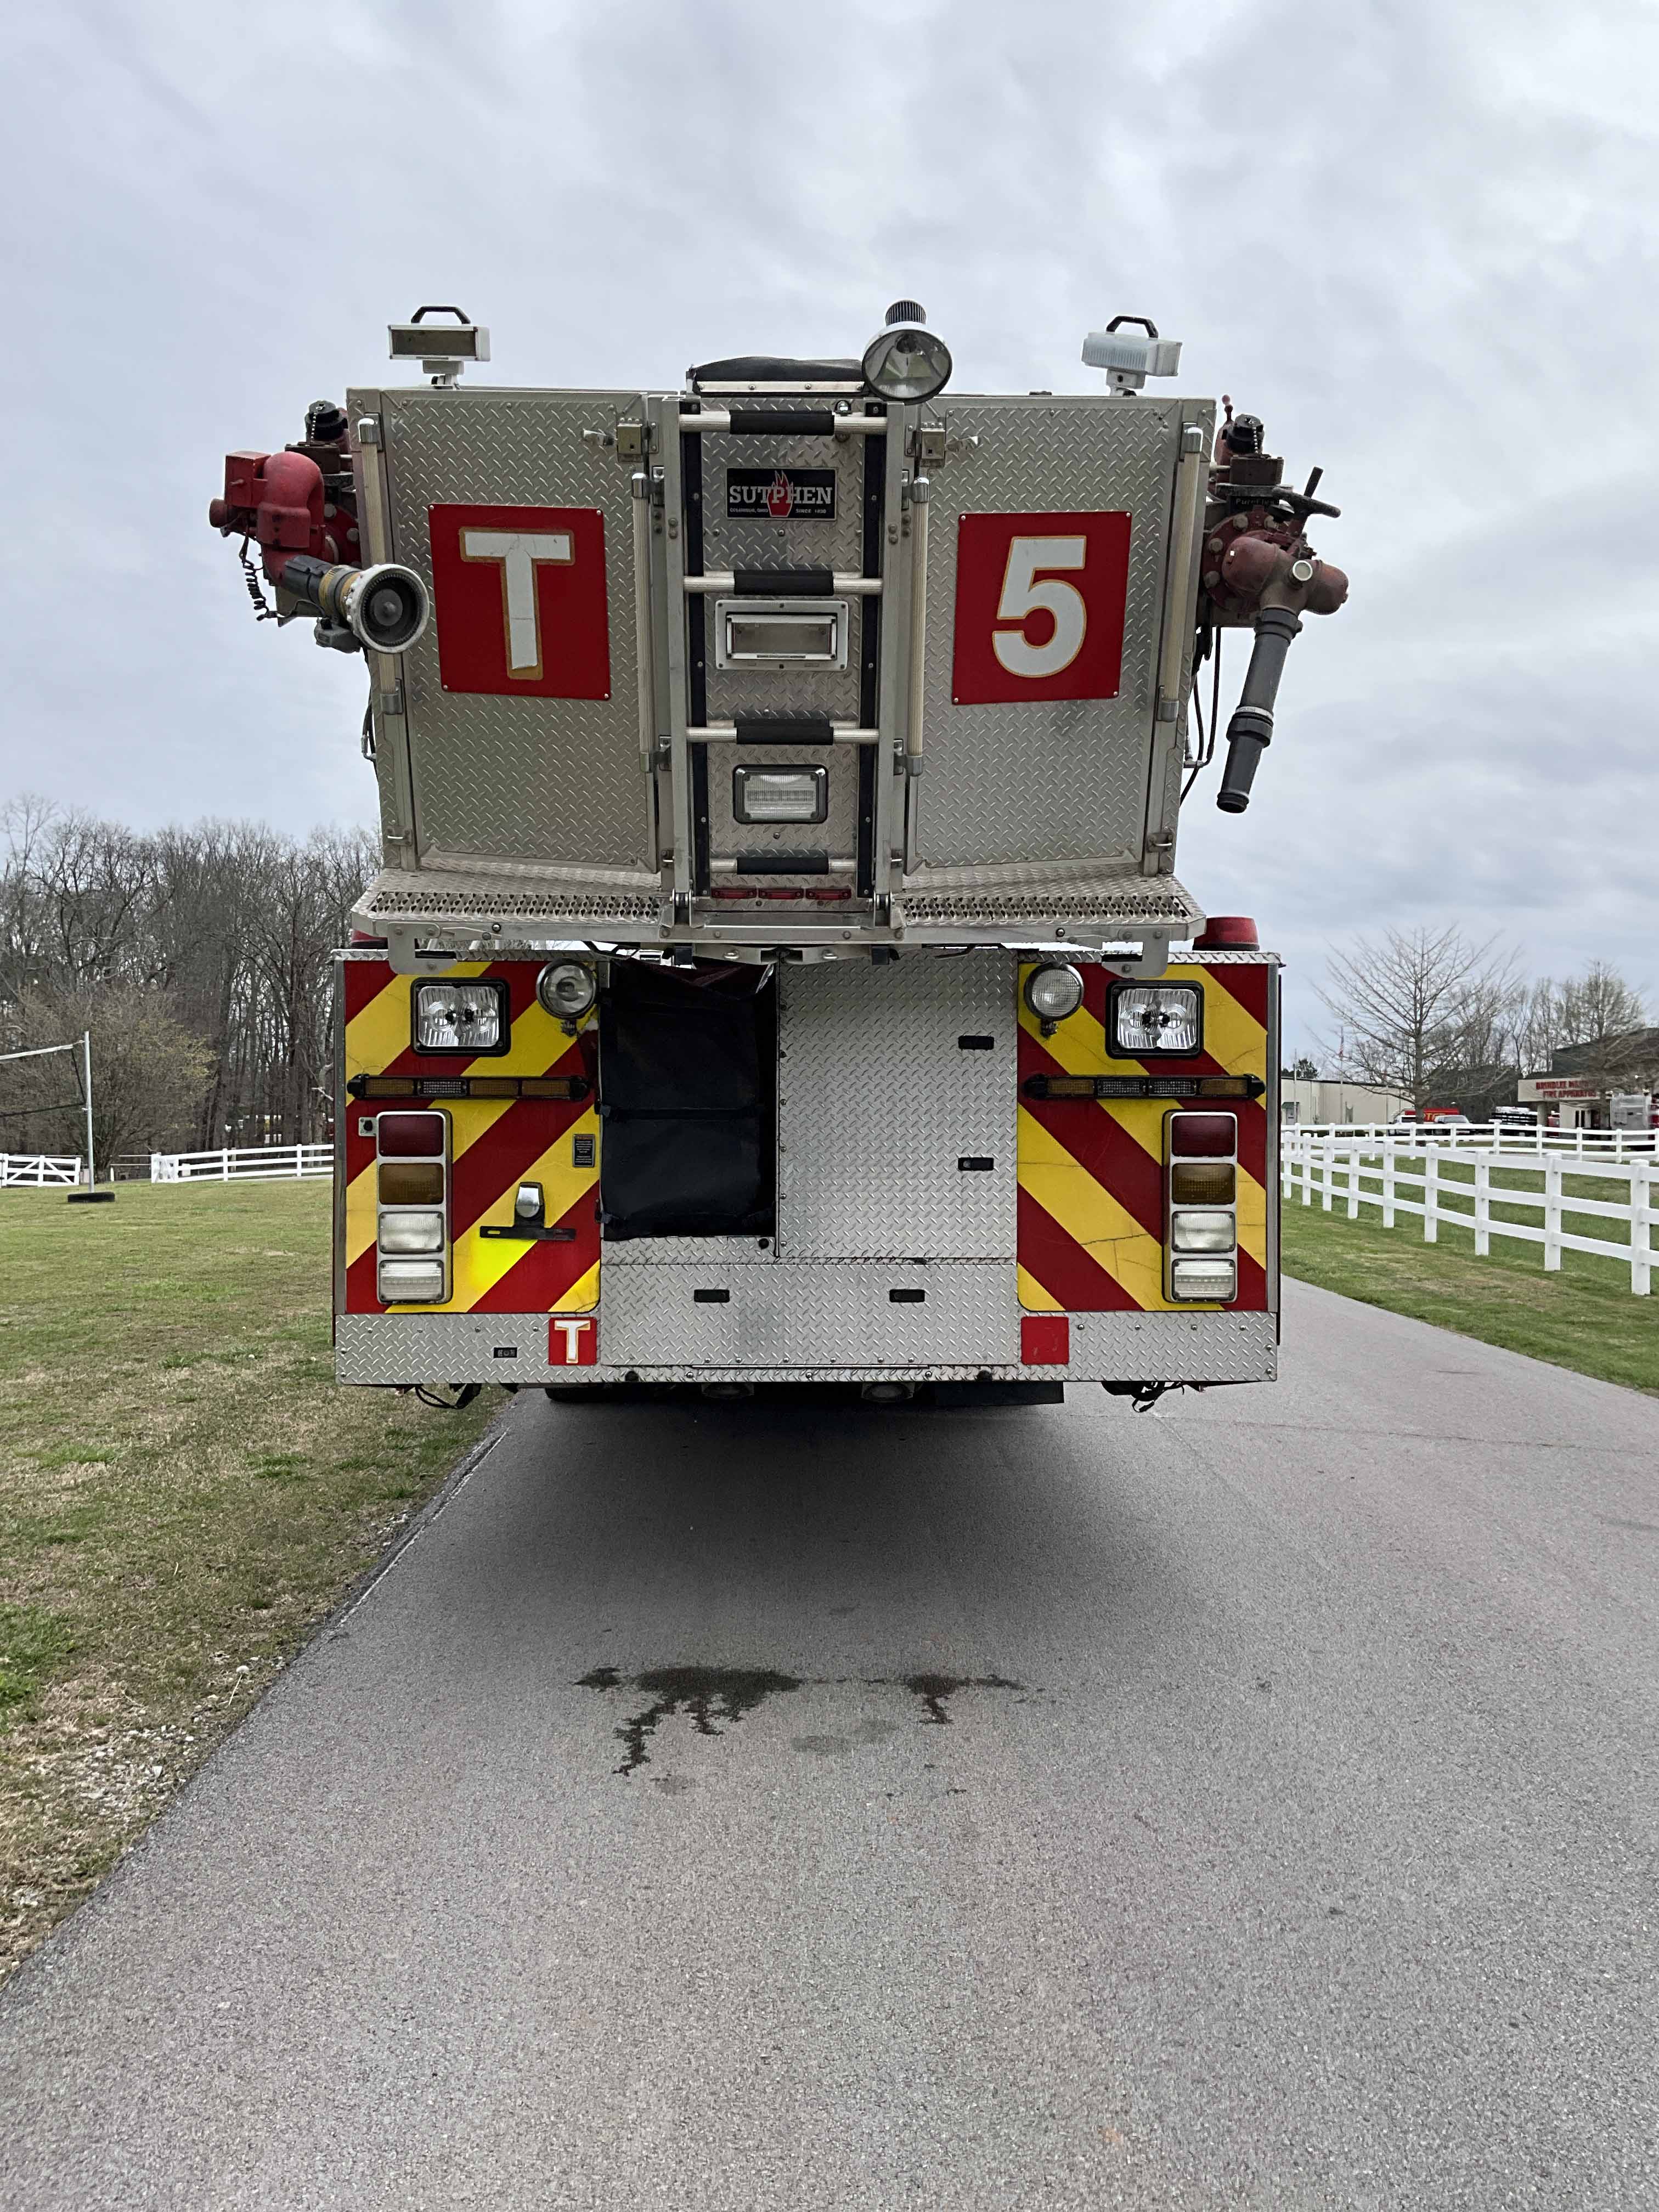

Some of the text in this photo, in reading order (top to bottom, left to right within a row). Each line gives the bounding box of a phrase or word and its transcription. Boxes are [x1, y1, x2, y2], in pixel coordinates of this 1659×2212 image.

[729, 485, 832, 505] SUTPHEN
[460, 527, 574, 680] T
[992, 535, 1087, 678] 5
[554, 1320, 591, 1364] T
